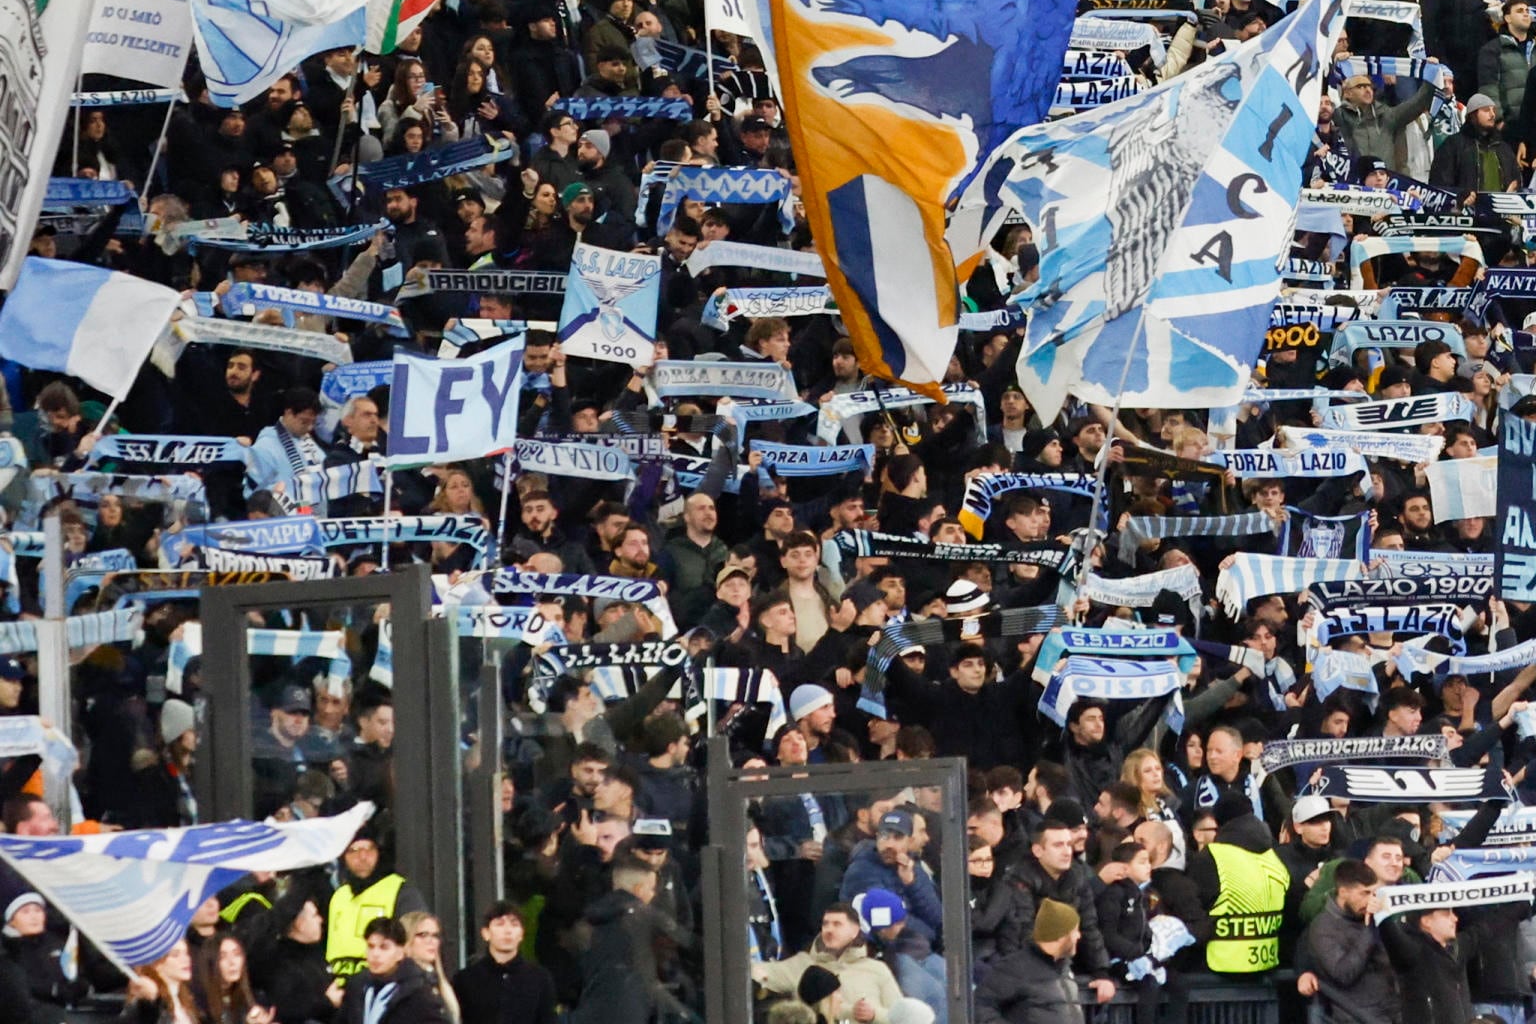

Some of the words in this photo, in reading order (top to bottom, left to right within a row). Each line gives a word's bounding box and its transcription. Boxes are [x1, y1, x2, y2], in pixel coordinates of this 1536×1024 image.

[111, 90, 156, 104] LAZIO
[1355, 192, 1397, 210] 1900
[604, 252, 661, 278] LAZIO
[1365, 325, 1445, 343] LAZIO
[590, 341, 637, 360] 1900
[1224, 454, 1278, 472] FORZA
[1300, 452, 1347, 471] LAZIO
[1318, 581, 1417, 598] LAZIO
[1424, 577, 1494, 597] 1900
[609, 641, 687, 666] LAZIO
[1287, 736, 1389, 759] IRRIDUCIBILI
[1391, 736, 1437, 753] LAZIO
[1388, 880, 1531, 908] IRRIDUCIBILI
